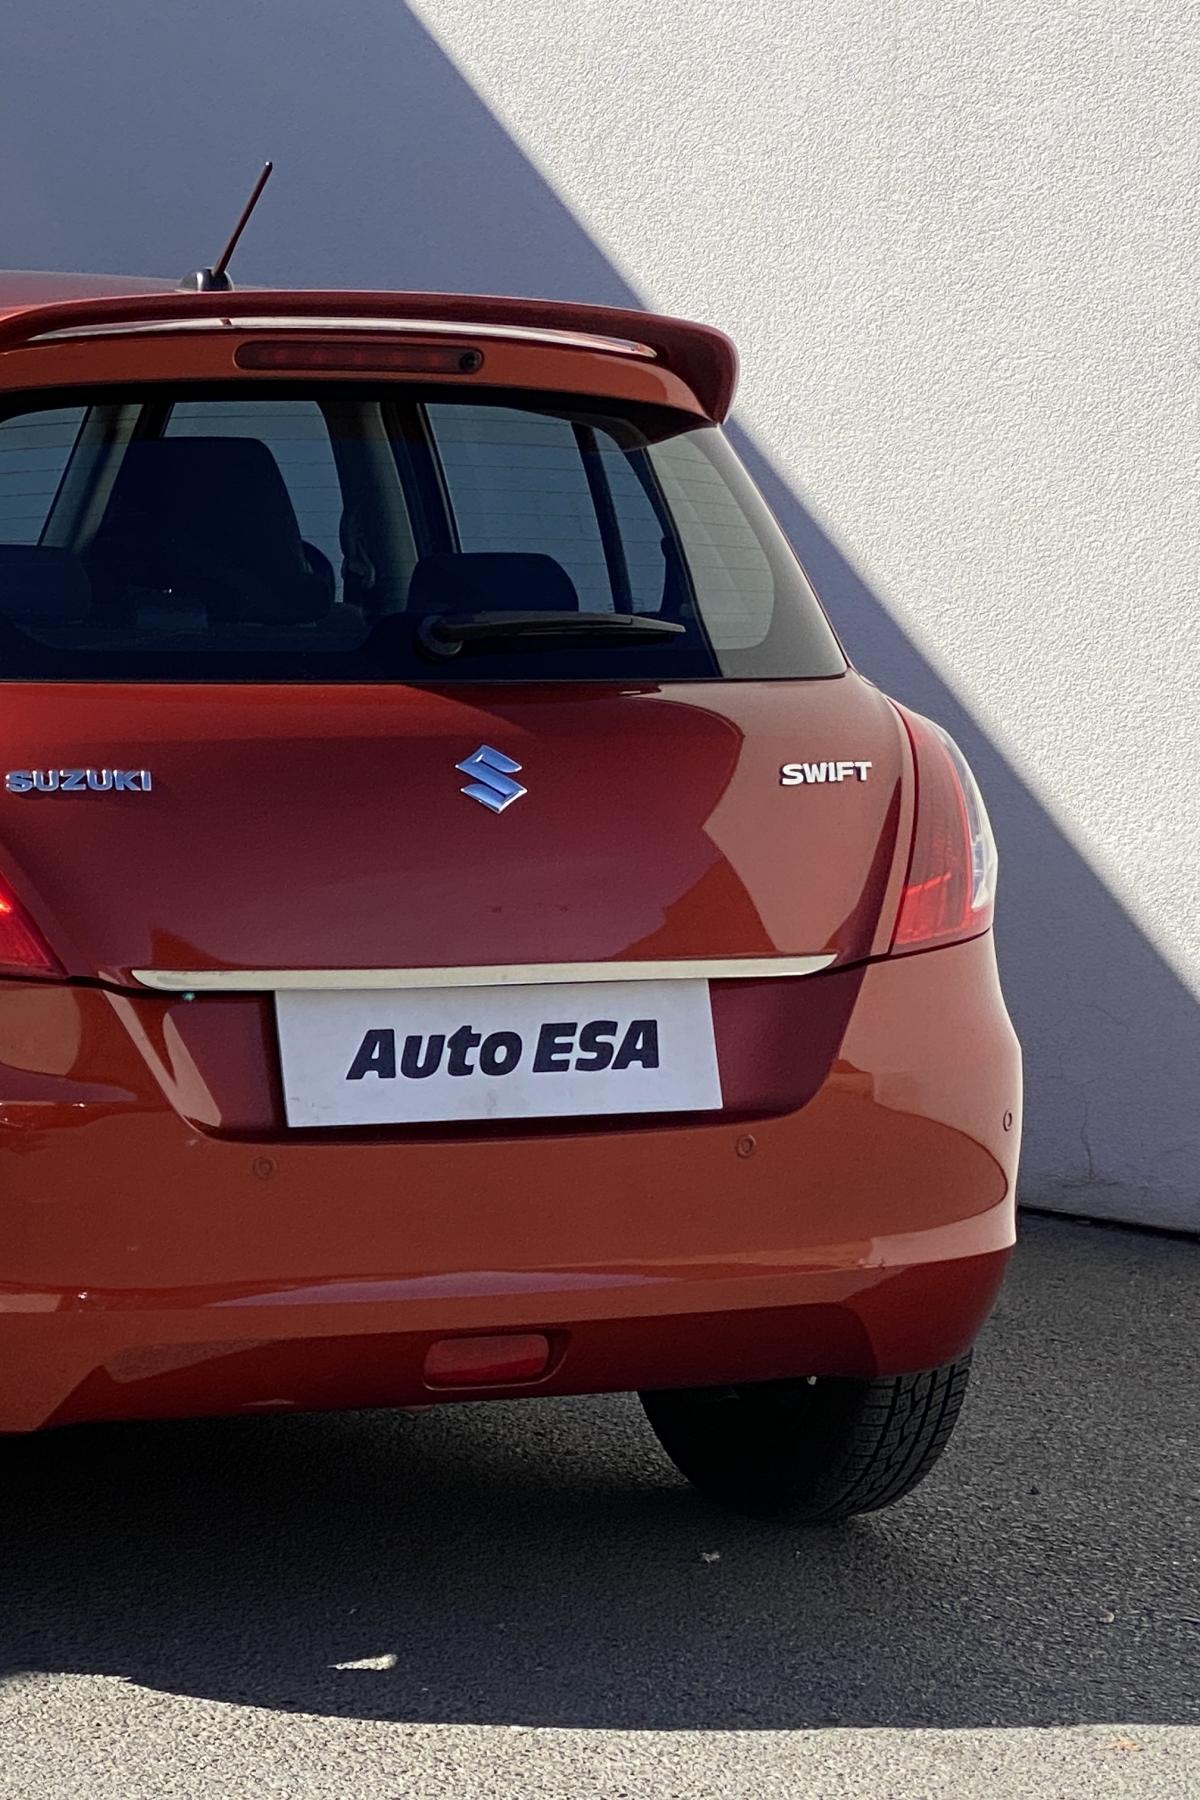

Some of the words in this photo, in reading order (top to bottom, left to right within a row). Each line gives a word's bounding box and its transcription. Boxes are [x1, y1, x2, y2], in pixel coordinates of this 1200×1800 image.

[5, 769, 153, 792] SUZUKI
[781, 760, 873, 786] SWIFT
[345, 1024, 523, 1081] Auto
[532, 1018, 661, 1073] ESA
